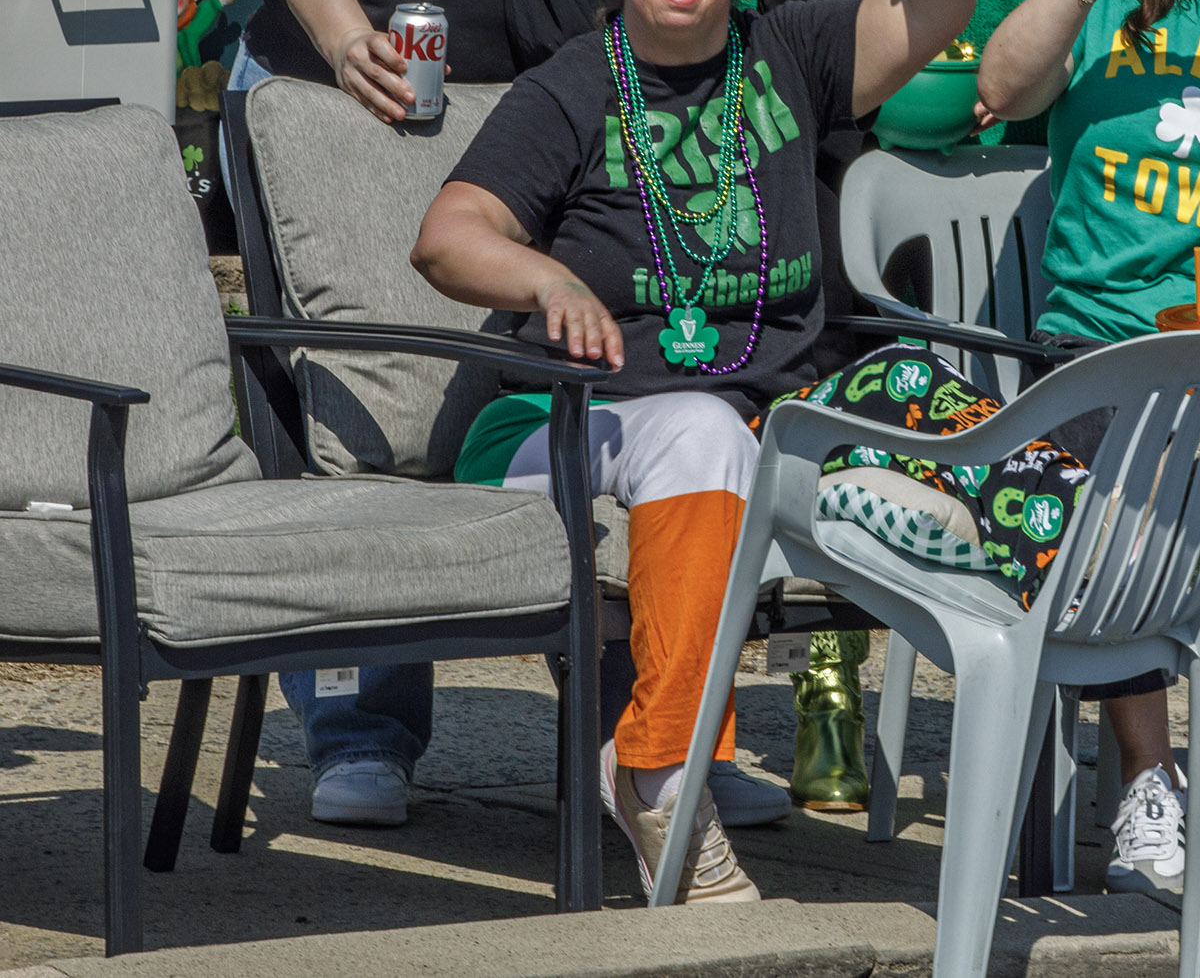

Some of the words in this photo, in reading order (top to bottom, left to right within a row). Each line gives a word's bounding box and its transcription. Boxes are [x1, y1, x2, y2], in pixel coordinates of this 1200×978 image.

[419, 22, 442, 33] Diet
[605, 59, 800, 188] IRISH
[633, 267, 692, 306] for
[703, 268, 759, 306] the
[768, 251, 812, 299] day
[672, 341, 706, 350] GUINNESS
[929, 379, 978, 421] GET
